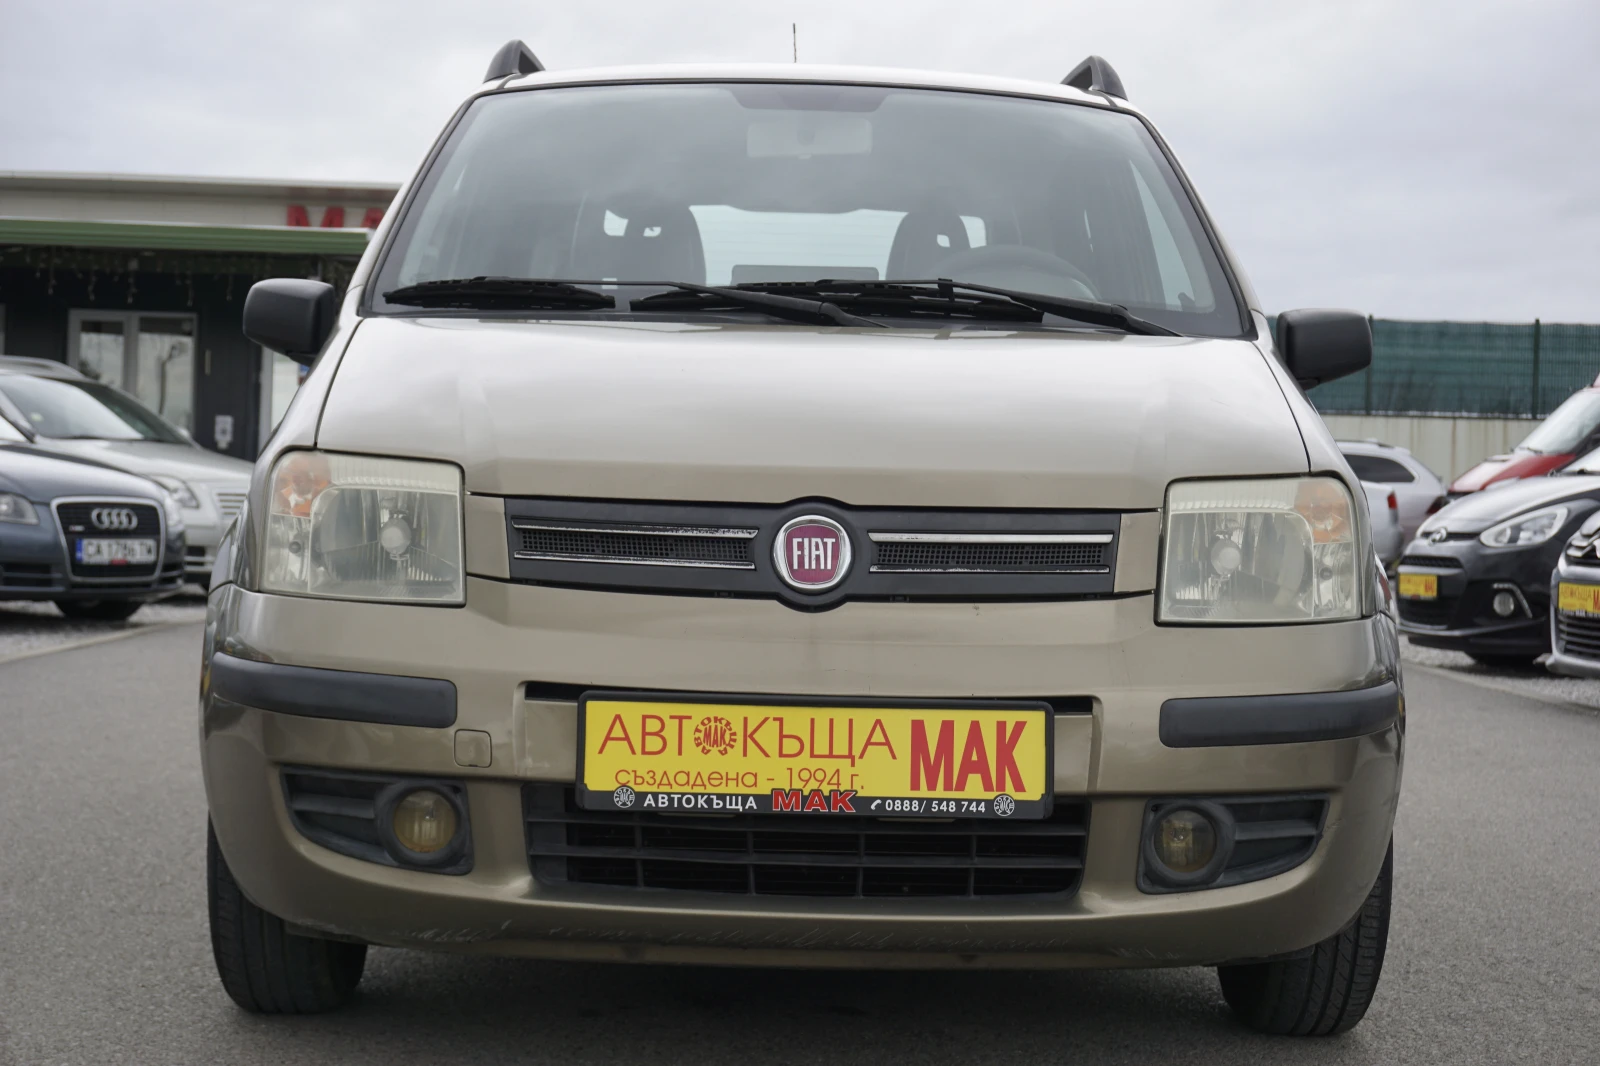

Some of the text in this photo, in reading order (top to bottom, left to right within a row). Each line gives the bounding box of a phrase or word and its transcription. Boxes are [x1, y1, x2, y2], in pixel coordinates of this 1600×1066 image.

[792, 538, 836, 570] FIAT
[703, 724, 727, 748] МАК
[910, 719, 1027, 793] МАК
[615, 769, 758, 790] създадена
[787, 768, 841, 789] 1994
[643, 793, 758, 812] АВТОКЪЩА
[773, 790, 857, 812] МАК
[885, 799, 926, 813] 0888/
[931, 800, 956, 812] 548
[961, 801, 986, 813] 744
